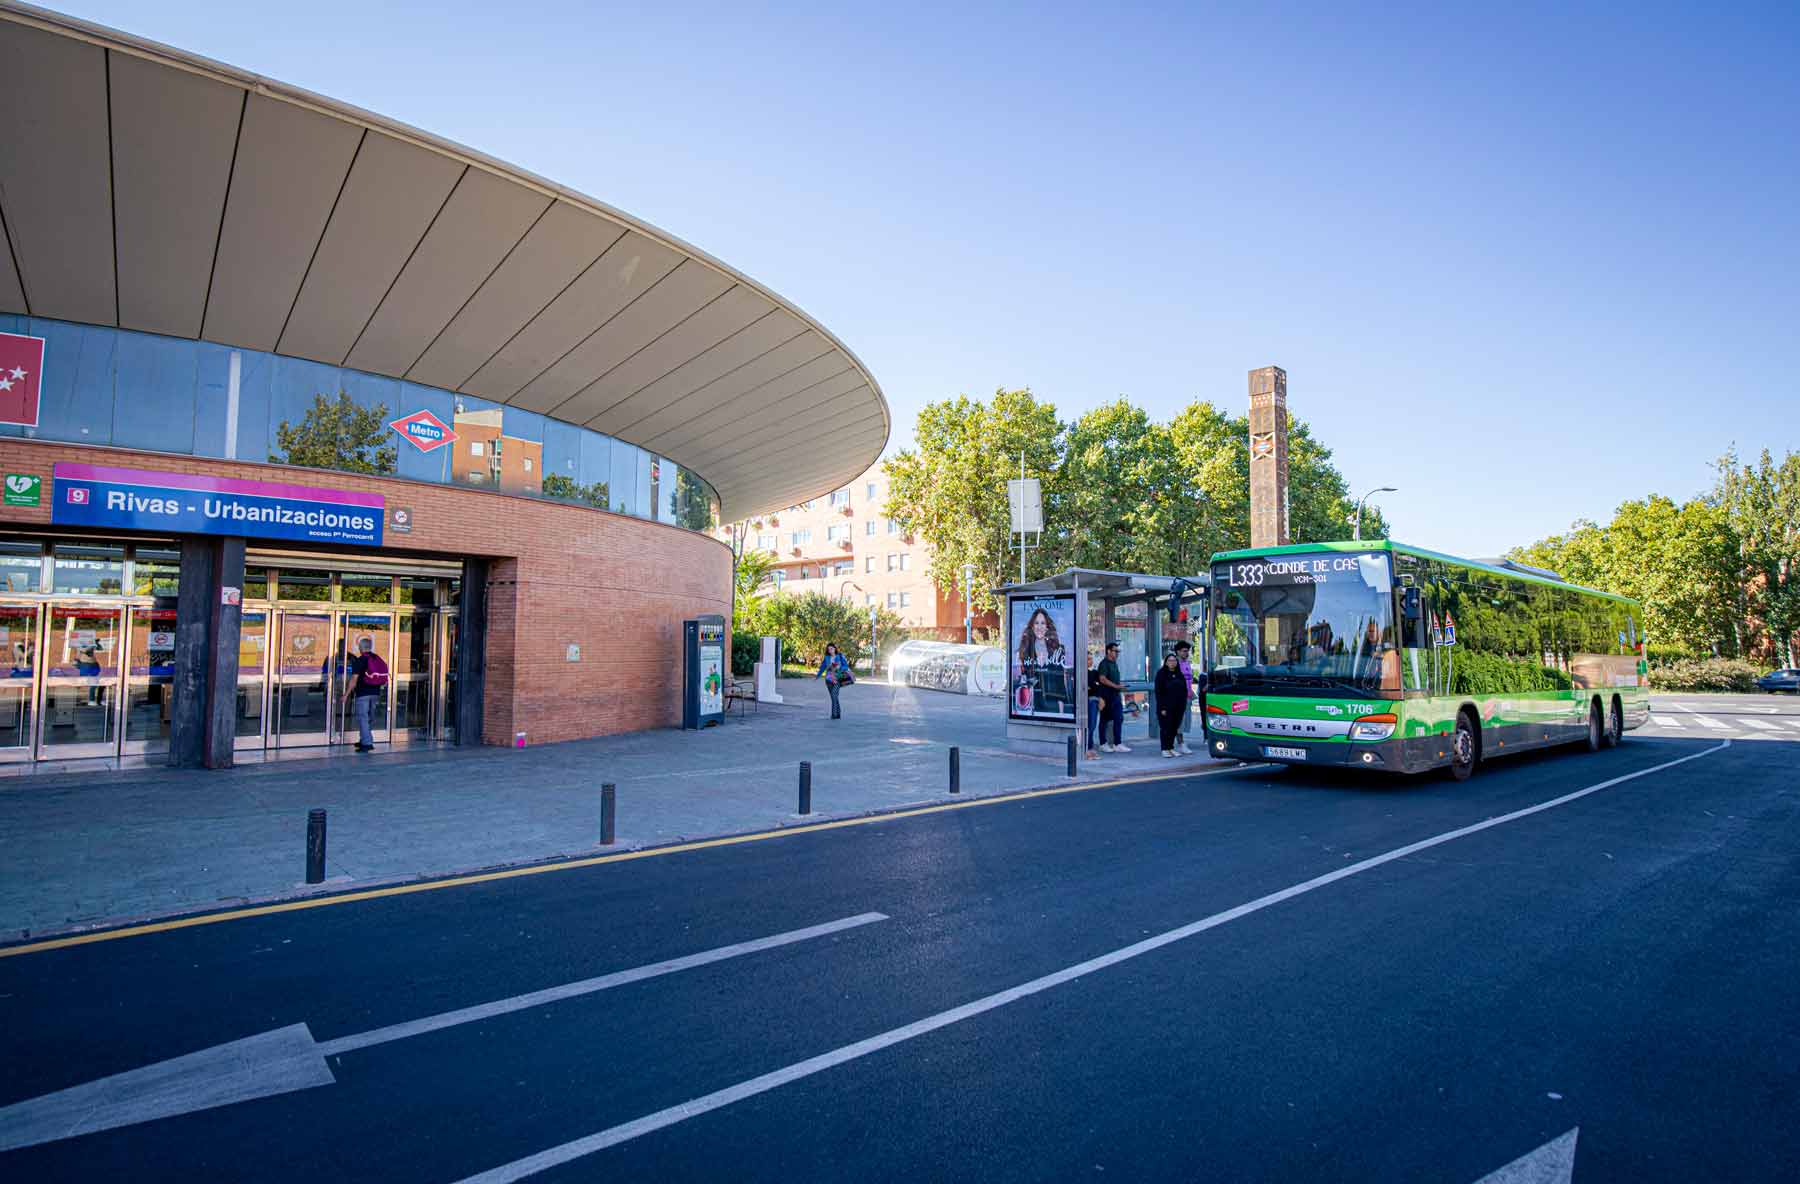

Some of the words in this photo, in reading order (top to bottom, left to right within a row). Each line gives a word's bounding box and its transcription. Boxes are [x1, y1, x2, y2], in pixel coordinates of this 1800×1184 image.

[410, 422, 441, 439] Metro
[72, 489, 85, 503] 9
[106, 490, 180, 515] Rivas
[186, 505, 197, 513] -
[203, 498, 375, 531] Urbanizaciones
[1229, 564, 1264, 587] L333
[1313, 559, 1330, 573] DE
[1345, 704, 1373, 715] 1706
[1253, 721, 1317, 732] SETRA
